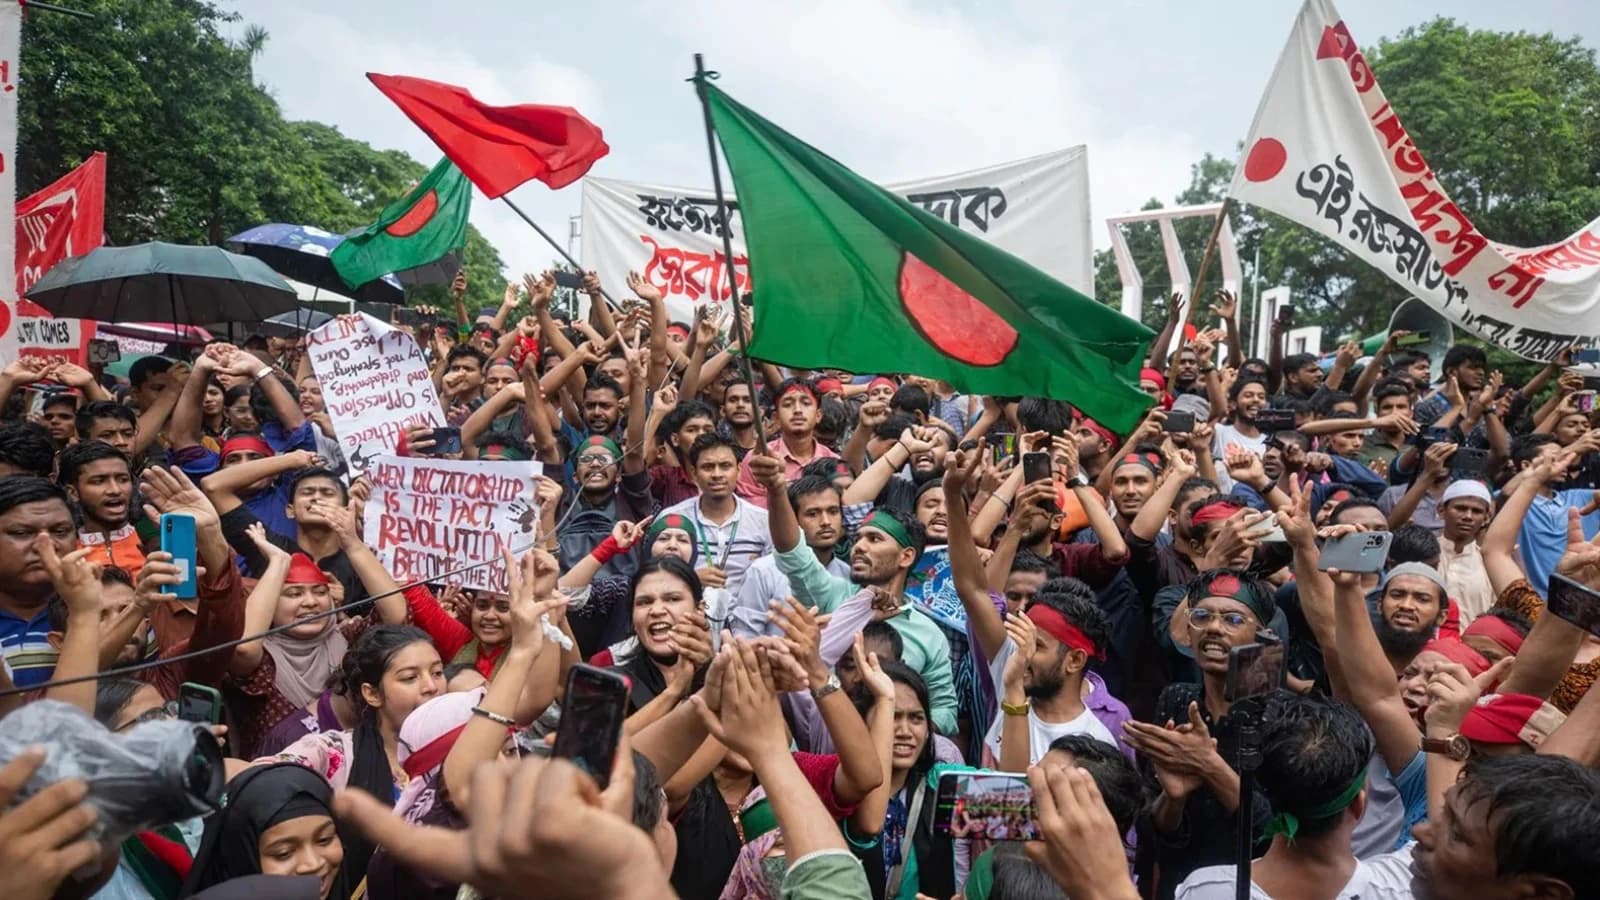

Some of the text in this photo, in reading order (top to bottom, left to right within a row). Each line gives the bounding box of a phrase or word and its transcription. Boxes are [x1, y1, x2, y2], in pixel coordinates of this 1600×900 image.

[1296, 154, 1354, 234] এই
[40, 320, 70, 345] COMES
[384, 354, 405, 369] not
[408, 344, 422, 361] by
[412, 466, 525, 501] DICTATORSHIP
[384, 491, 400, 513] IS
[406, 493, 443, 522] THE
[378, 513, 513, 563] REVOLUTION
[464, 567, 487, 590] THE
